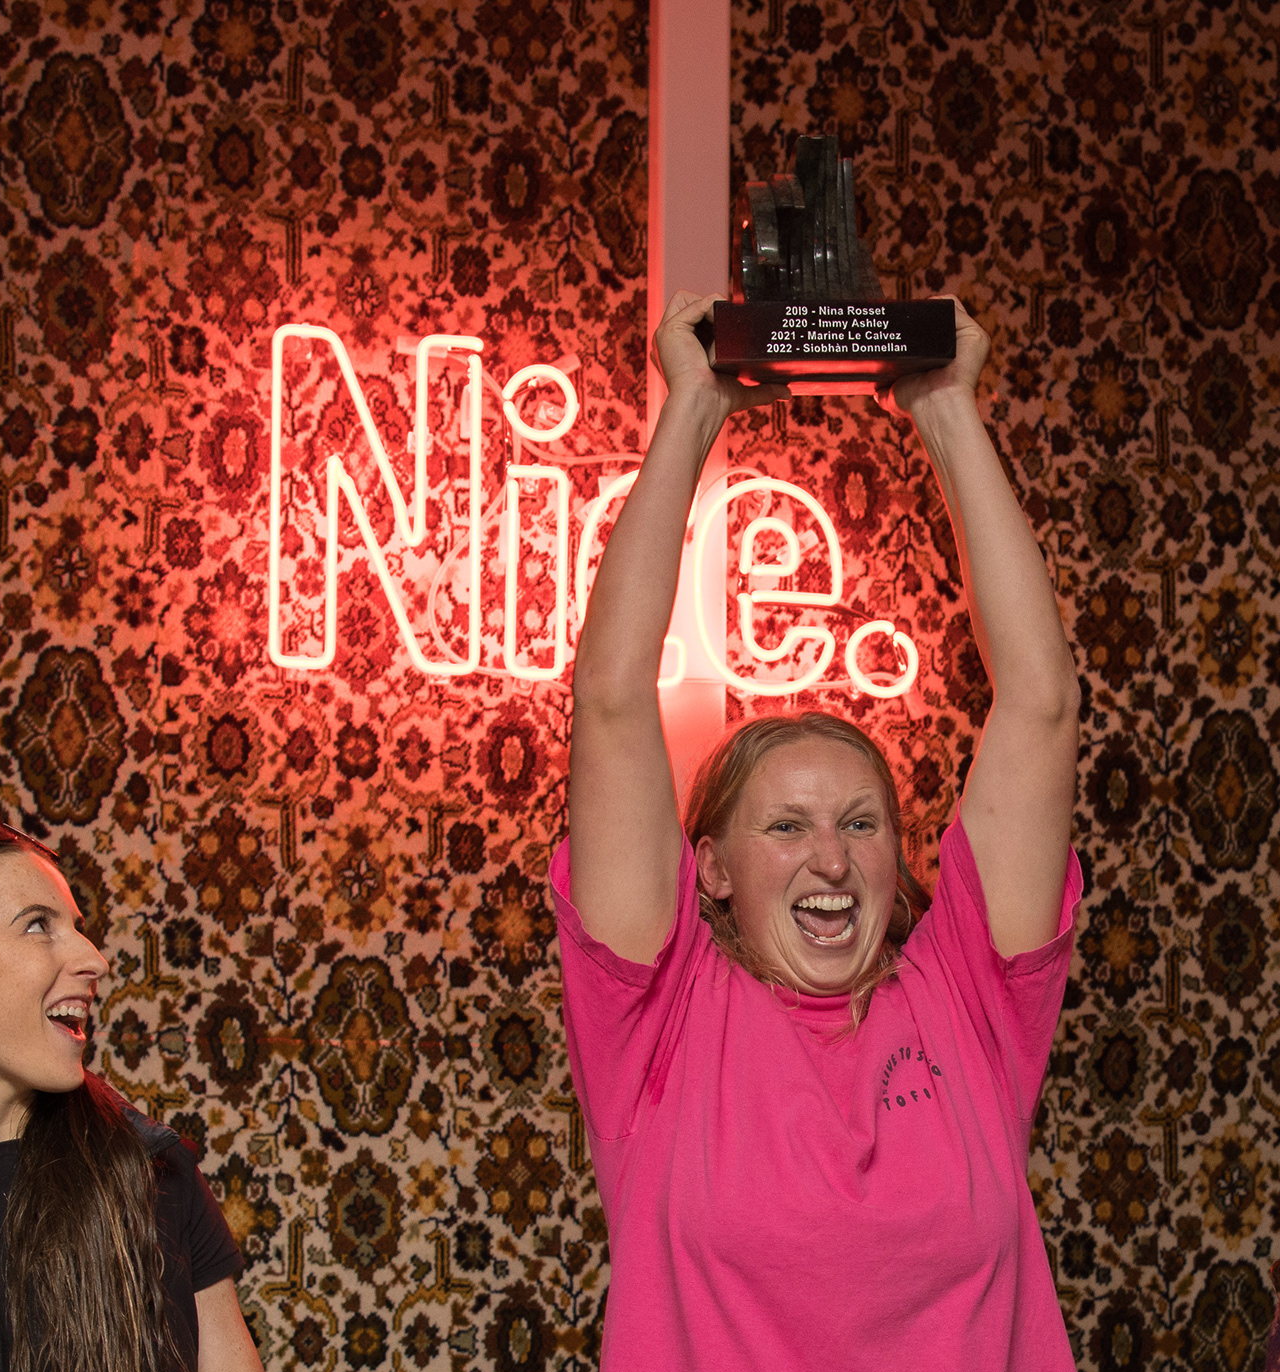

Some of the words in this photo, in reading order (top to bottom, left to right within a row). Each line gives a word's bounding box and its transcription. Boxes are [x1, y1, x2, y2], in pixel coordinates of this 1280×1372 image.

[785, 306, 808, 316] 2019
[819, 306, 844, 316] Nina
[847, 306, 886, 316] Rosset
[782, 318, 808, 328] 2020
[818, 318, 848, 330] Immy
[851, 318, 889, 330] Ashley
[771, 331, 796, 341] 2021
[807, 331, 845, 341] Marine
[848, 331, 862, 341] Le
[865, 331, 902, 341] Calvez
[766, 343, 793, 353] 2022
[852, 343, 908, 353] Donnellan
[899, 1046, 911, 1060] TO
